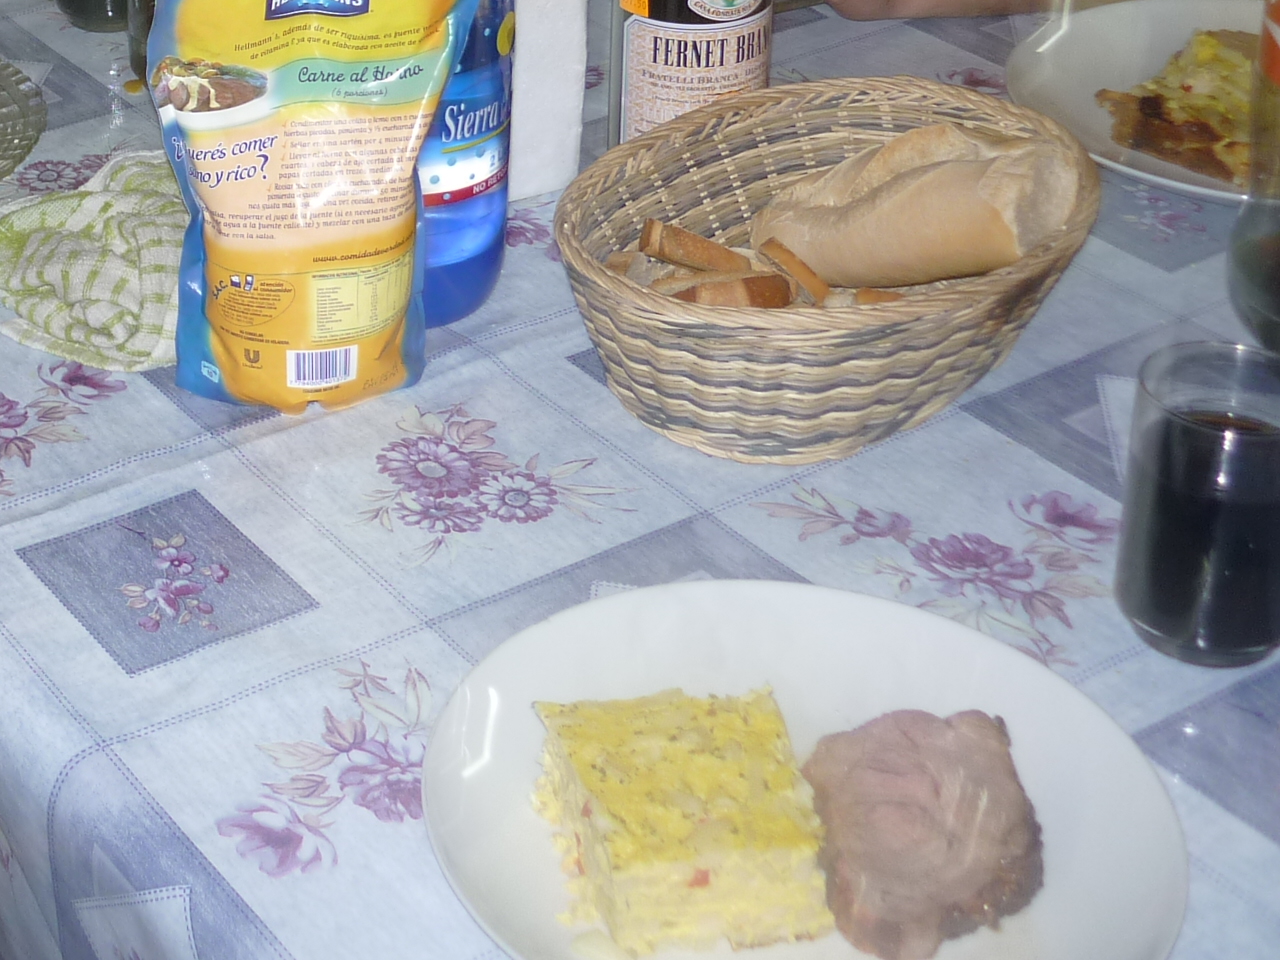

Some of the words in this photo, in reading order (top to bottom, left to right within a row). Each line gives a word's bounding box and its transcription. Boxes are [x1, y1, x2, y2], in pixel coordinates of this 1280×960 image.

[314, 24, 324, 32] de
[651, 36, 729, 68] FERNET
[298, 66, 345, 83] Carne
[350, 67, 368, 82] al
[442, 101, 498, 142] Sierra
[231, 135, 278, 156] comer
[209, 170, 225, 189] y
[472, 182, 486, 195] NO
[223, 221, 241, 229] agua
